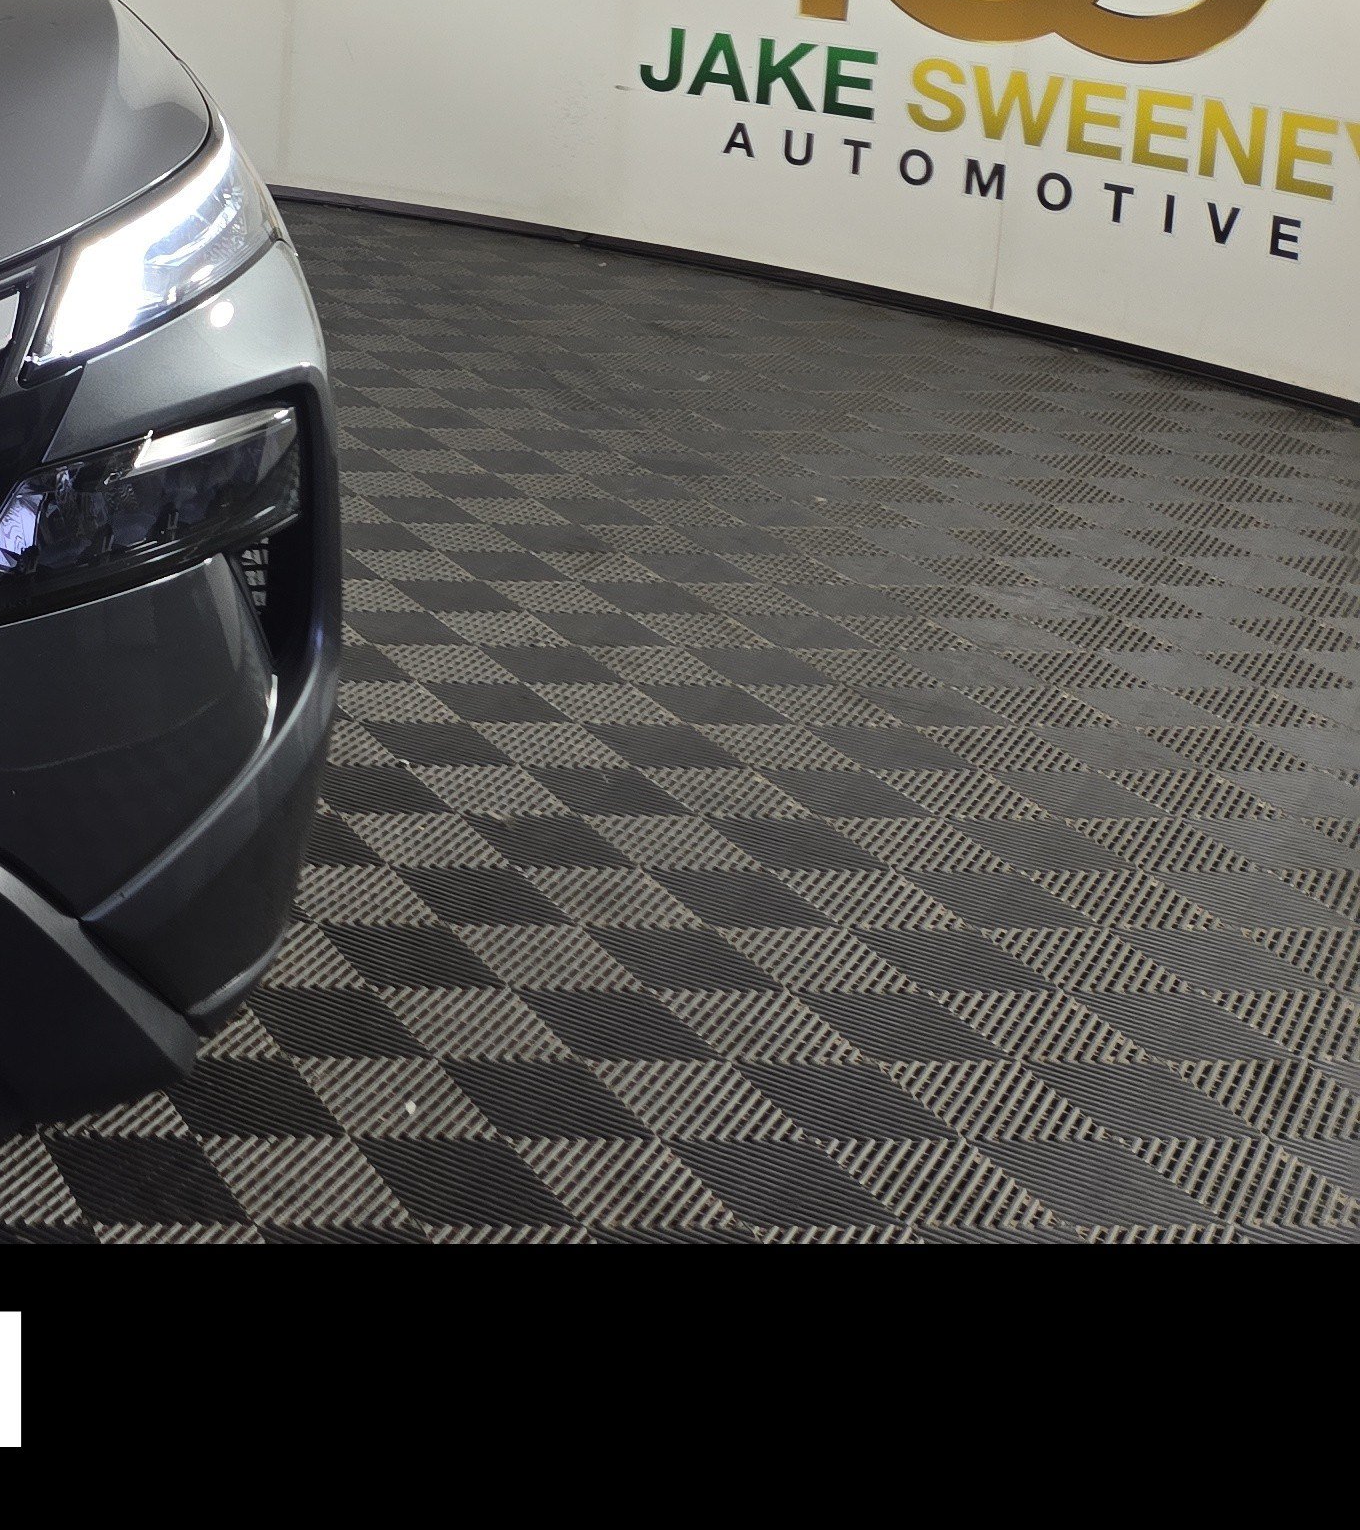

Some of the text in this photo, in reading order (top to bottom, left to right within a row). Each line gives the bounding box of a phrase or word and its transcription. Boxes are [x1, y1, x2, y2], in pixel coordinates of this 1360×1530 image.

[638, 27, 1360, 202] JAKE SWEENE
[722, 121, 1303, 262] AUTOMOTIVE
